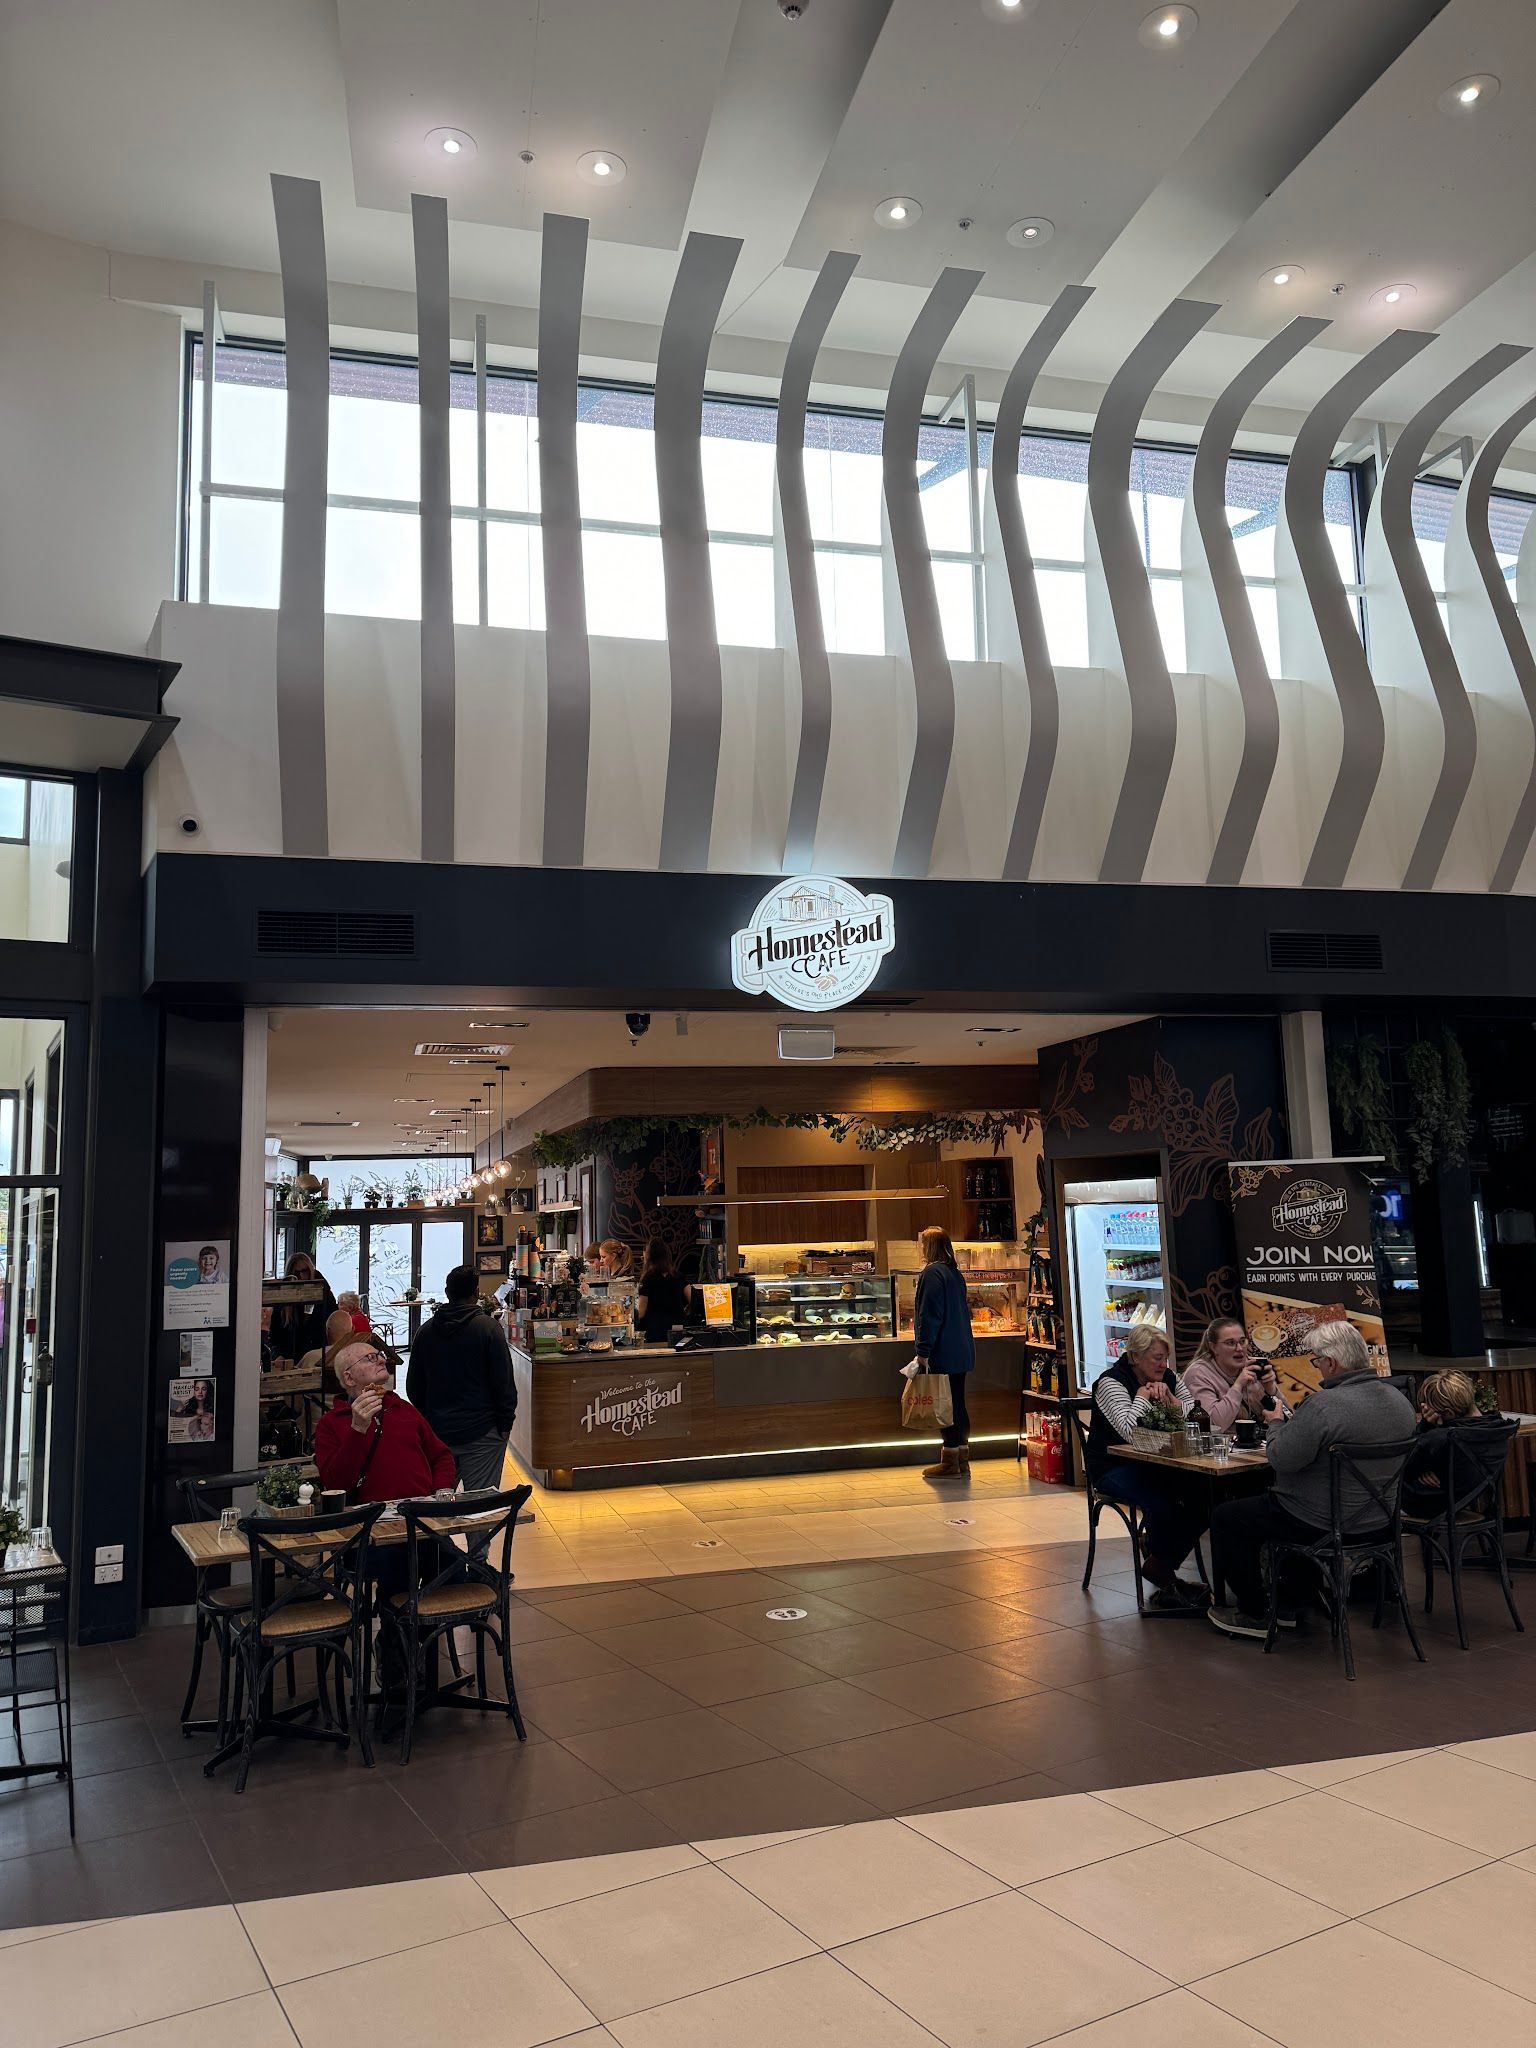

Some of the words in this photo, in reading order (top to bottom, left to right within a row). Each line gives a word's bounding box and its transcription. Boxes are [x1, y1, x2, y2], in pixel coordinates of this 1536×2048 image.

[749, 915, 883, 970] Homestead
[792, 949, 850, 979] CAFE
[1276, 1195, 1344, 1224] Homestead
[1297, 1213, 1327, 1228] CAFE
[1246, 1246, 1310, 1265] JOIN
[1323, 1245, 1374, 1264] NOW
[1246, 1273, 1267, 1283] EARN
[1269, 1272, 1296, 1283] POINTS
[1298, 1272, 1319, 1282] WITH
[1320, 1272, 1343, 1282] EVERY
[1346, 1271, 1376, 1282] PURCHAS
[600, 1386, 635, 1401] Welcome
[636, 1381, 643, 1389] to
[645, 1378, 657, 1387] the
[907, 1394, 933, 1405] coles
[580, 1382, 682, 1433] Homestead
[612, 1410, 657, 1436] CAFE
